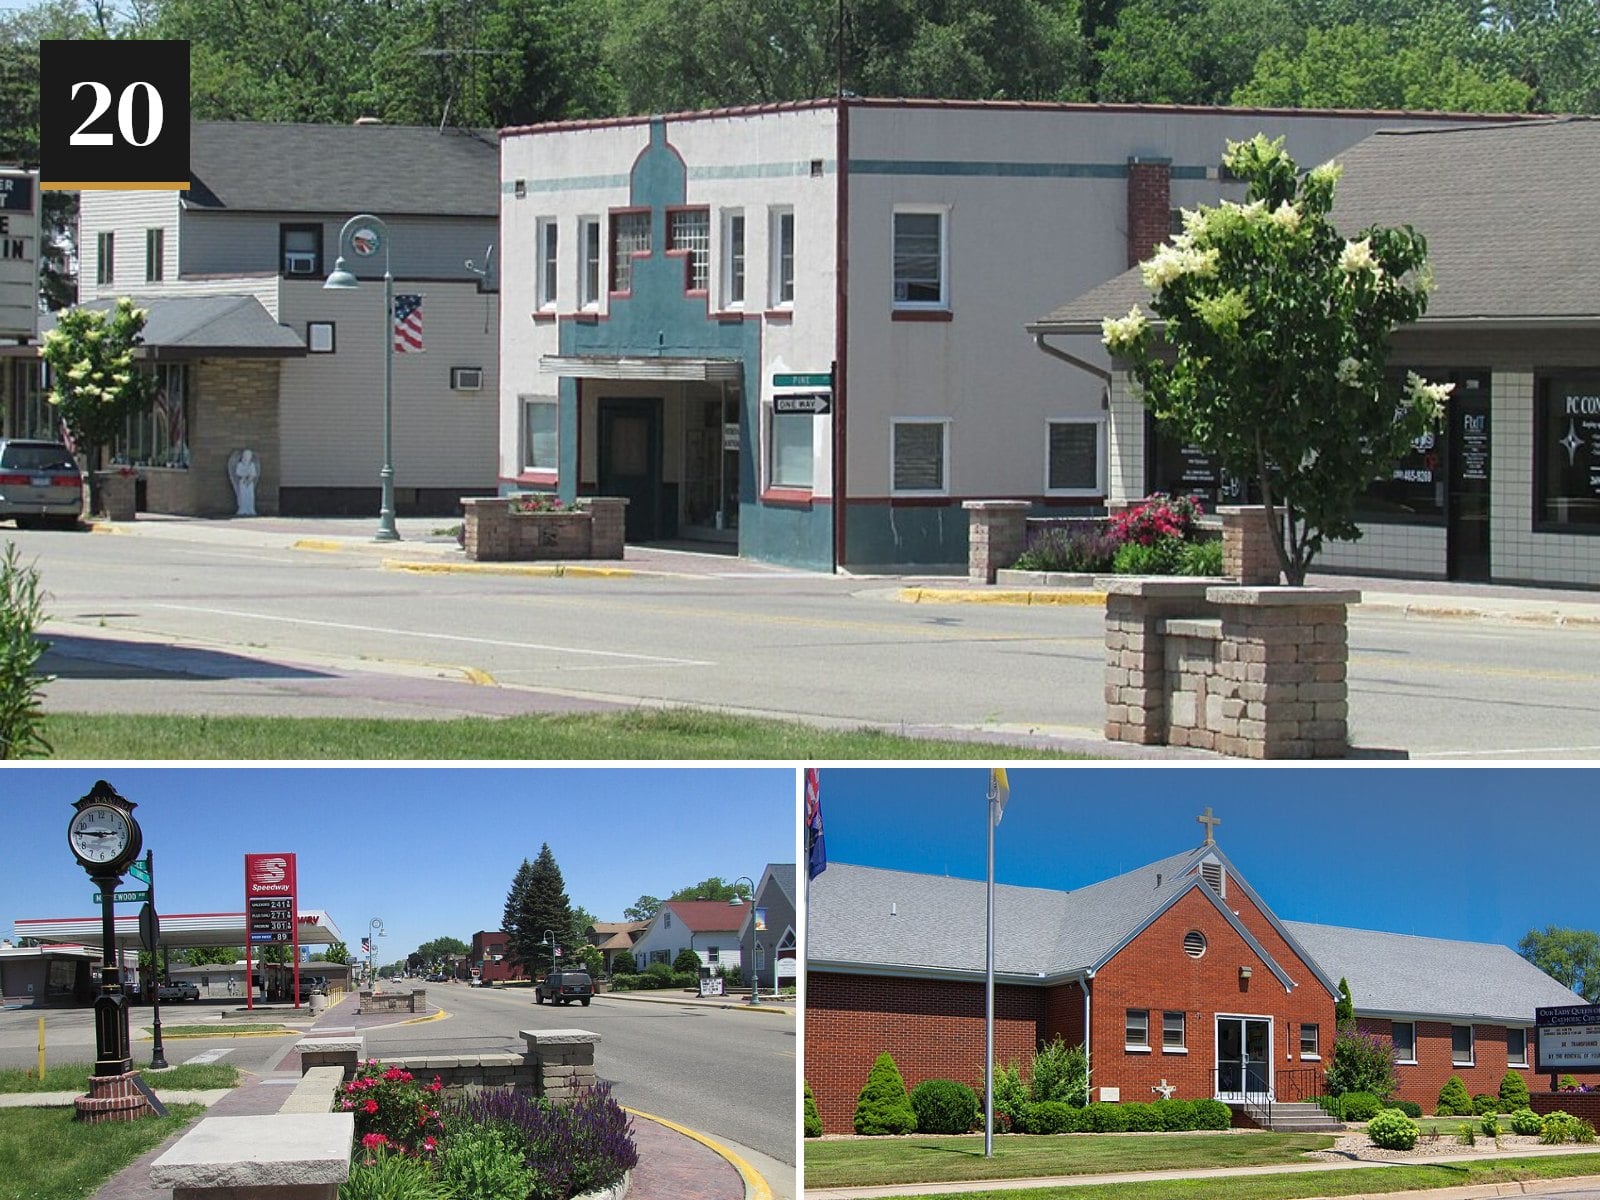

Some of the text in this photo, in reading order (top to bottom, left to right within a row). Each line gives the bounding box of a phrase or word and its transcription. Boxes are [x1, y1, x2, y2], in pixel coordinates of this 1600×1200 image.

[779, 400, 816, 409] ONE WAY
[252, 884, 290, 892] Speedway
[96, 893, 136, 902] MEWOOD
[271, 911, 285, 919] 271
[271, 922, 286, 930] 301
